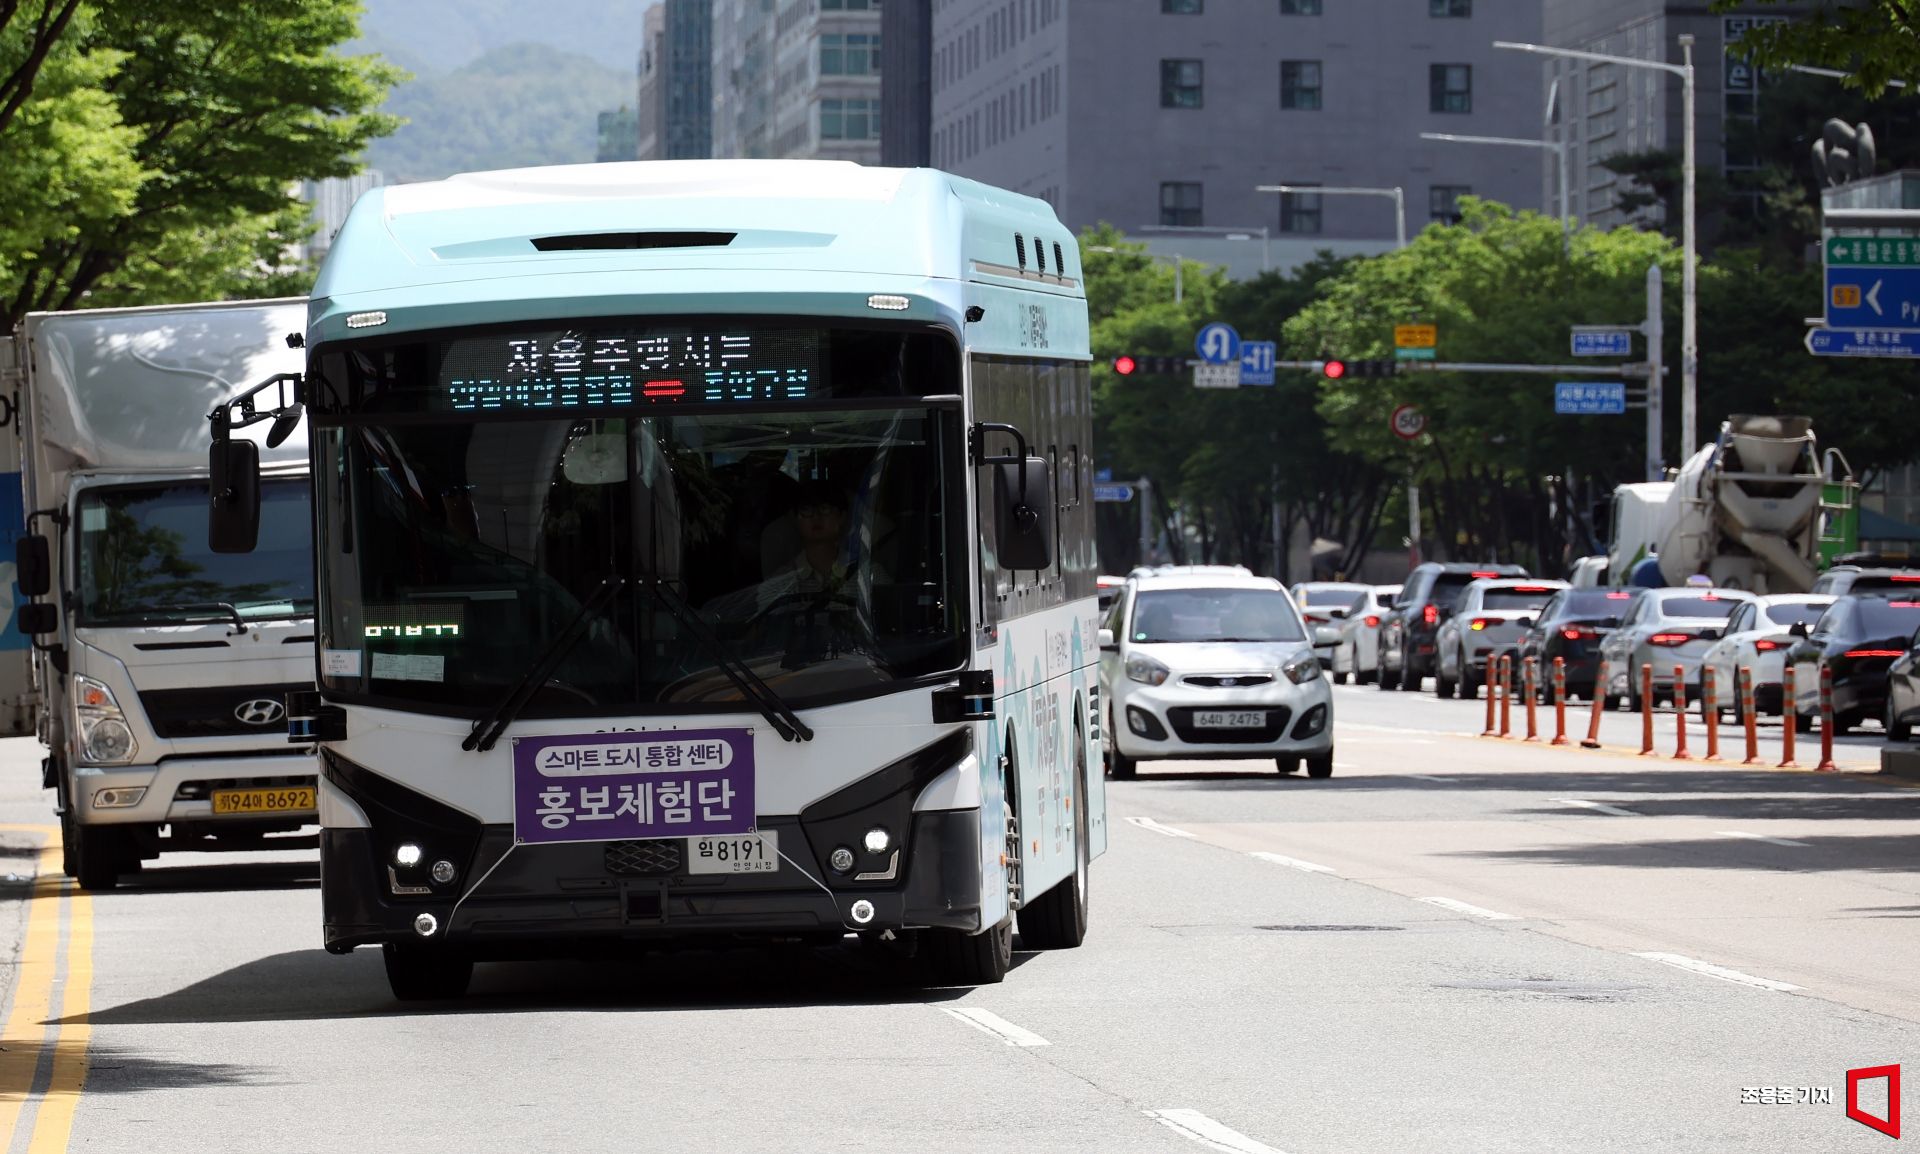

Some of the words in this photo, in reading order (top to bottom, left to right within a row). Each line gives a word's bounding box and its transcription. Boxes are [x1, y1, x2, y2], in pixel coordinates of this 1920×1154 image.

[544, 748, 601, 771] 스마트
[604, 747, 641, 769] 도시
[645, 745, 683, 768] 통합
[686, 743, 723, 765] 센터
[266, 791, 308, 809] 8692
[535, 779, 736, 829] 홍보체험단
